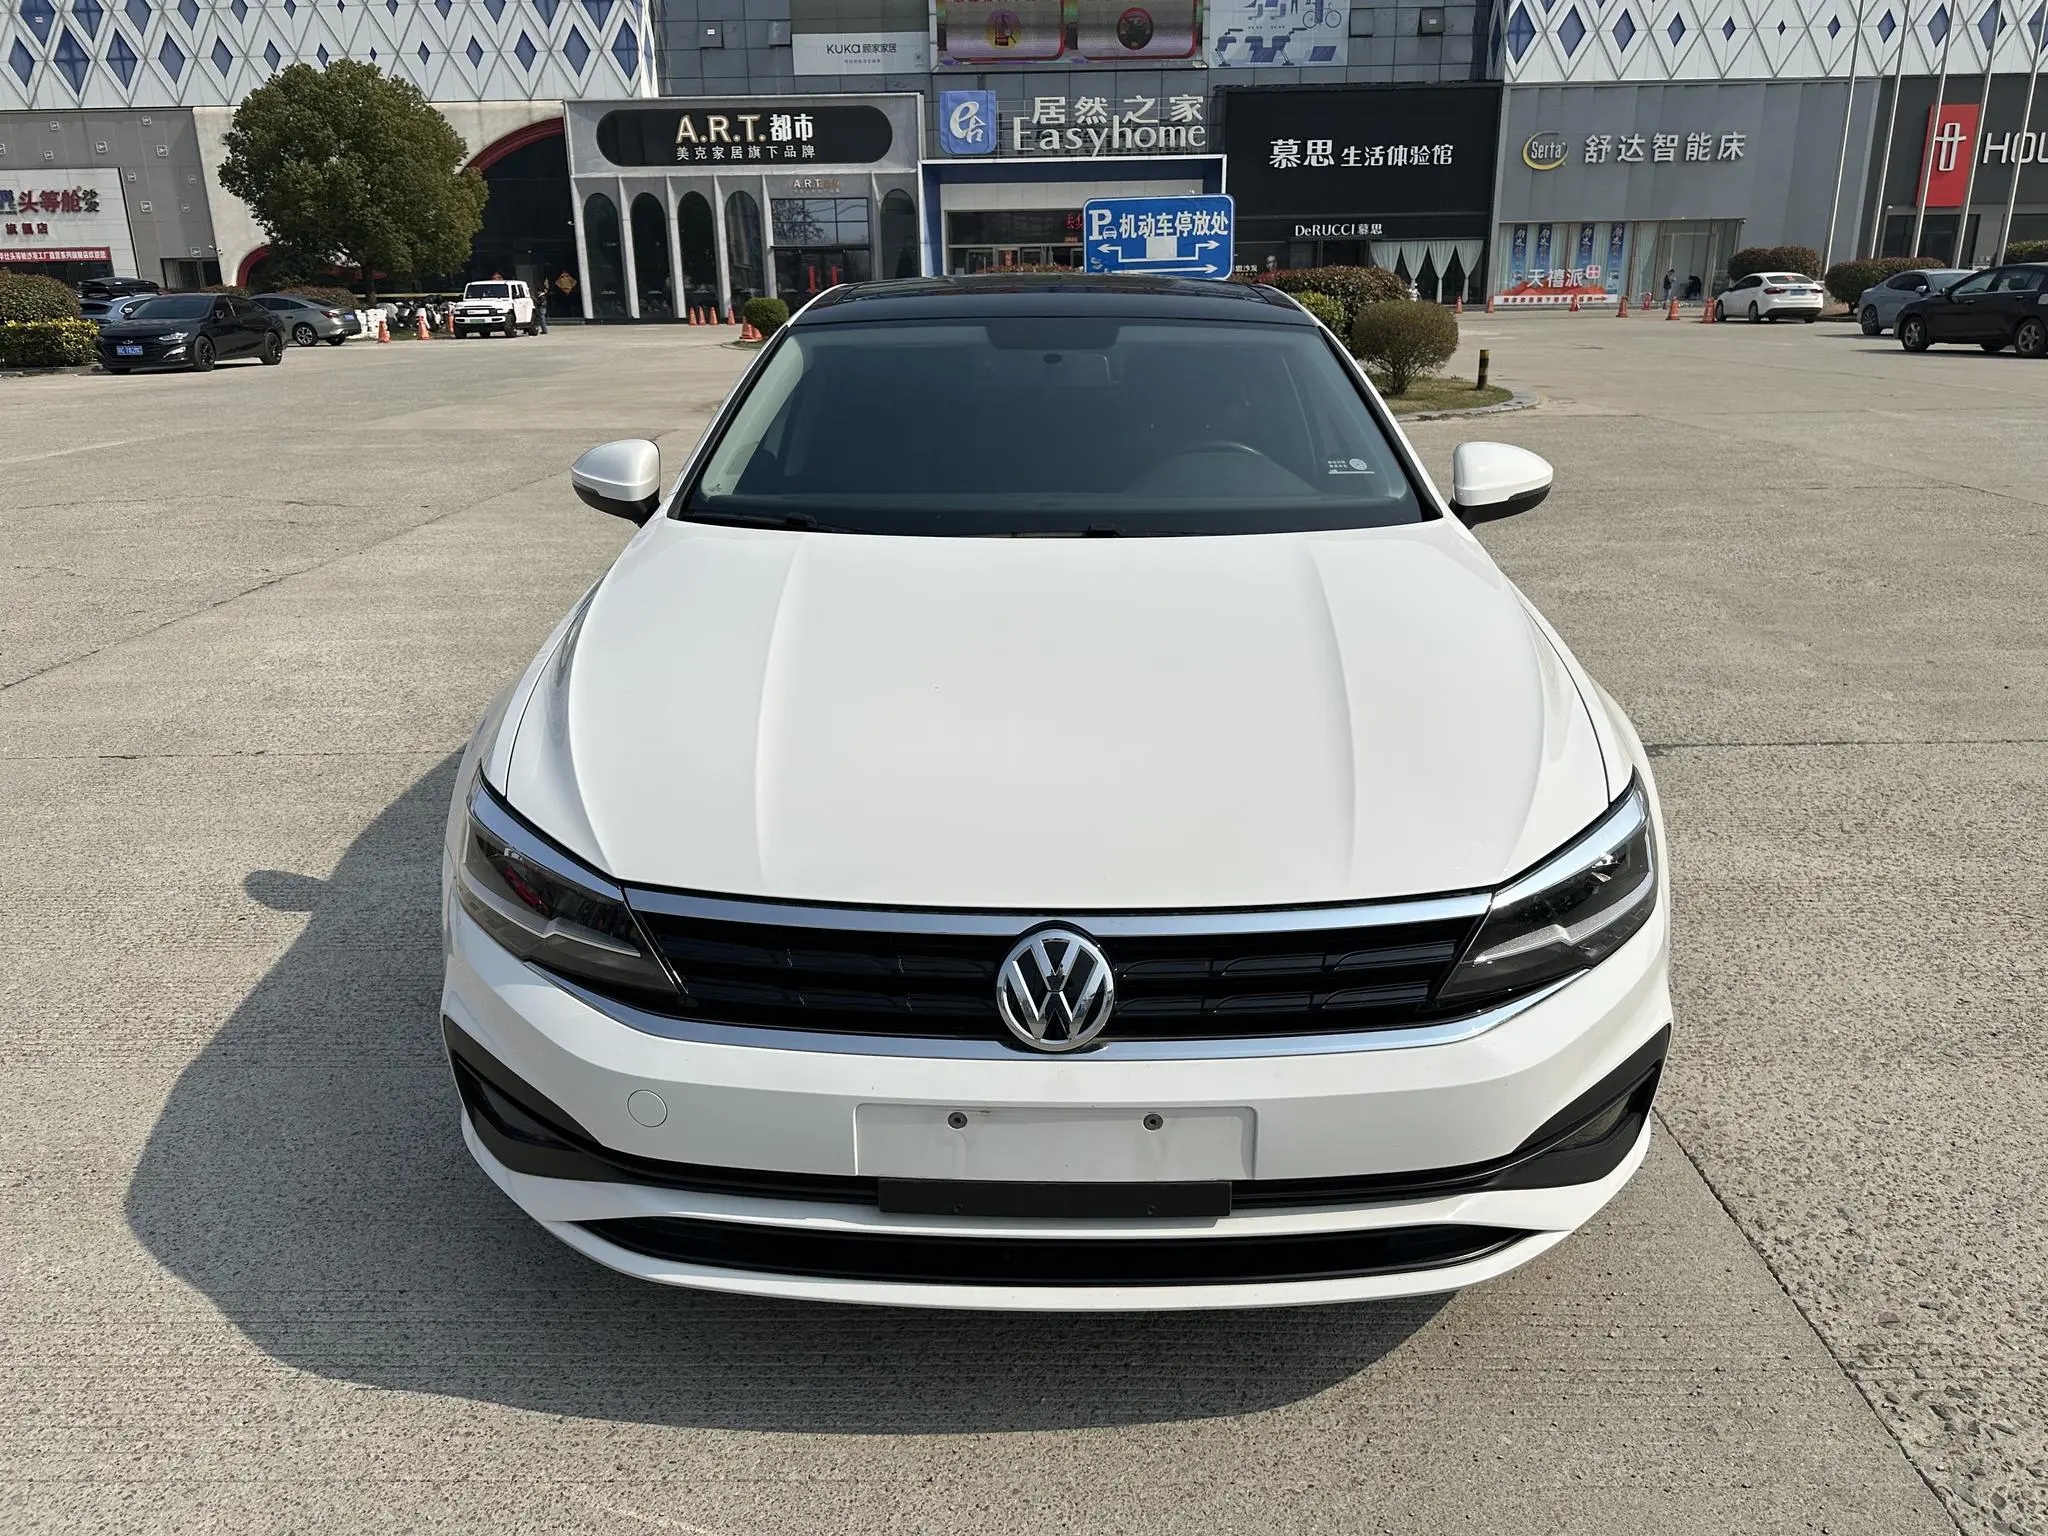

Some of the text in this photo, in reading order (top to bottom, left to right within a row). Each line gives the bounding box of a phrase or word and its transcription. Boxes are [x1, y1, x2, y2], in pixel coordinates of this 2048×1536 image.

[1032, 94, 1204, 125] 居然之家
[1013, 115, 1206, 157] Easyhome
[1531, 131, 1747, 163] Serta 舒达智能床
[676, 145, 816, 161] 美克家居旗下品牌
[1269, 139, 1454, 169] 慕思 生活体验馆
[1088, 209, 1113, 240] P
[1119, 210, 1229, 239] 机动车停放处
[1295, 223, 1355, 237] DeRUCCI
